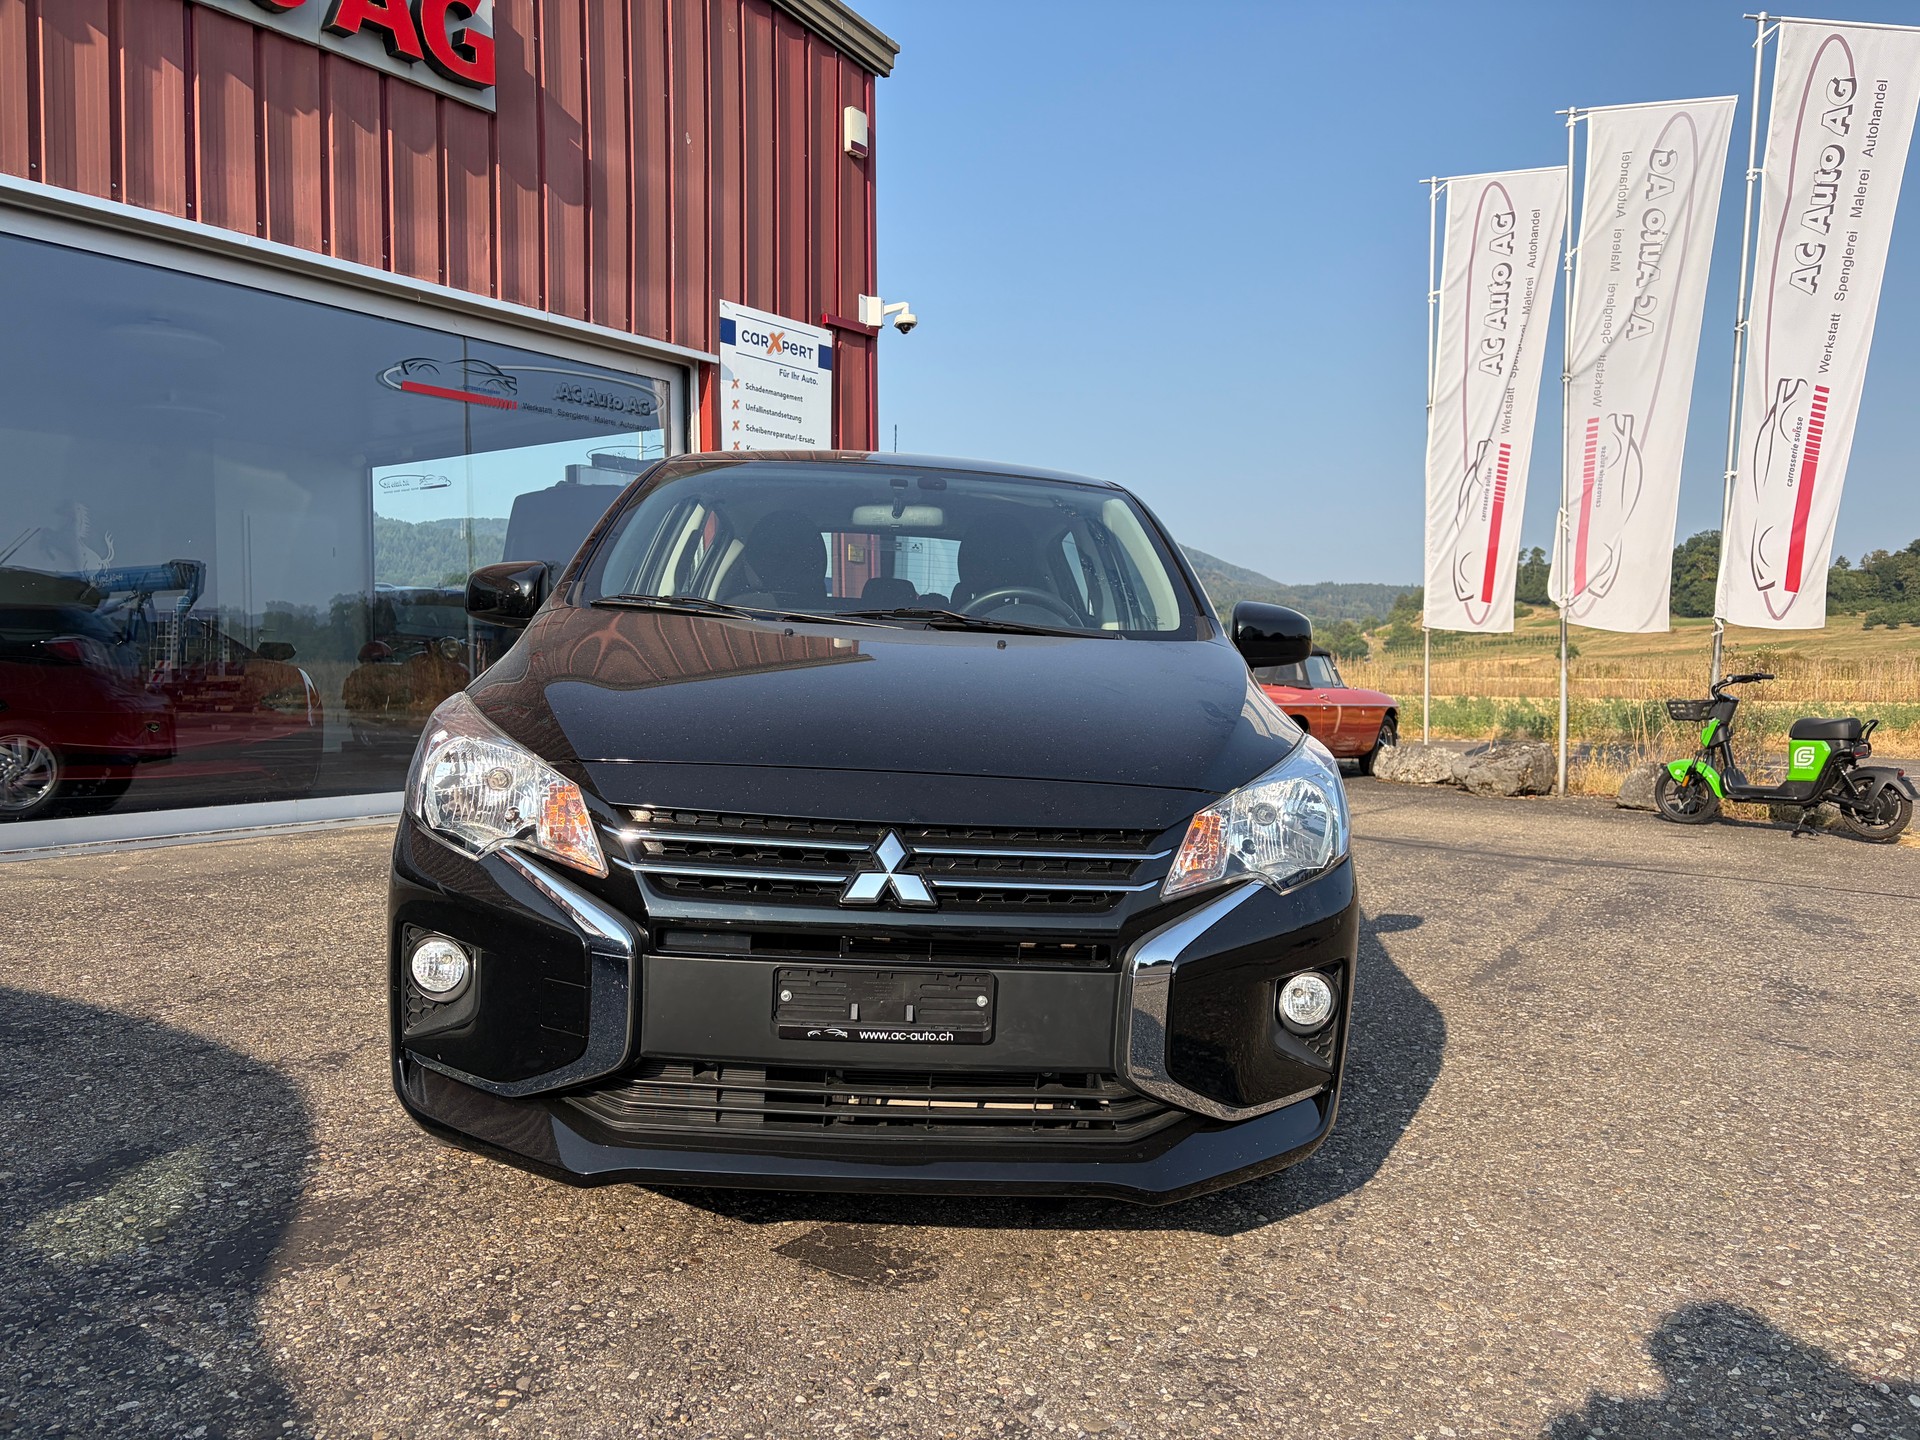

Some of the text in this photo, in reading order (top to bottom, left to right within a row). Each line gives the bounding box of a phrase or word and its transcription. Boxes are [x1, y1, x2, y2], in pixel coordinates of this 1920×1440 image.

[322, 0, 496, 90] AG
[1789, 76, 1857, 296] AC Auto AG
[1527, 208, 1541, 269] Autohandel
[1818, 79, 1889, 374] Werkstatt Spenglerei Malerei Autohandel
[1478, 210, 1516, 377] AC Auto AG
[1522, 277, 1534, 315] Malerei
[745, 382, 803, 402] Schadenmanagement
[778, 368, 819, 386] Für Ihr Auto.
[557, 382, 582, 403] AC
[627, 396, 651, 416] AG
[745, 403, 802, 424] Unfallinstandsetzung
[1501, 387, 1515, 434] Werkstatt
[1787, 416, 1804, 488] carrosserie suisse
[1481, 488, 1490, 522] carrosserie
[859, 1031, 954, 1041] www.ac-auto.ch
